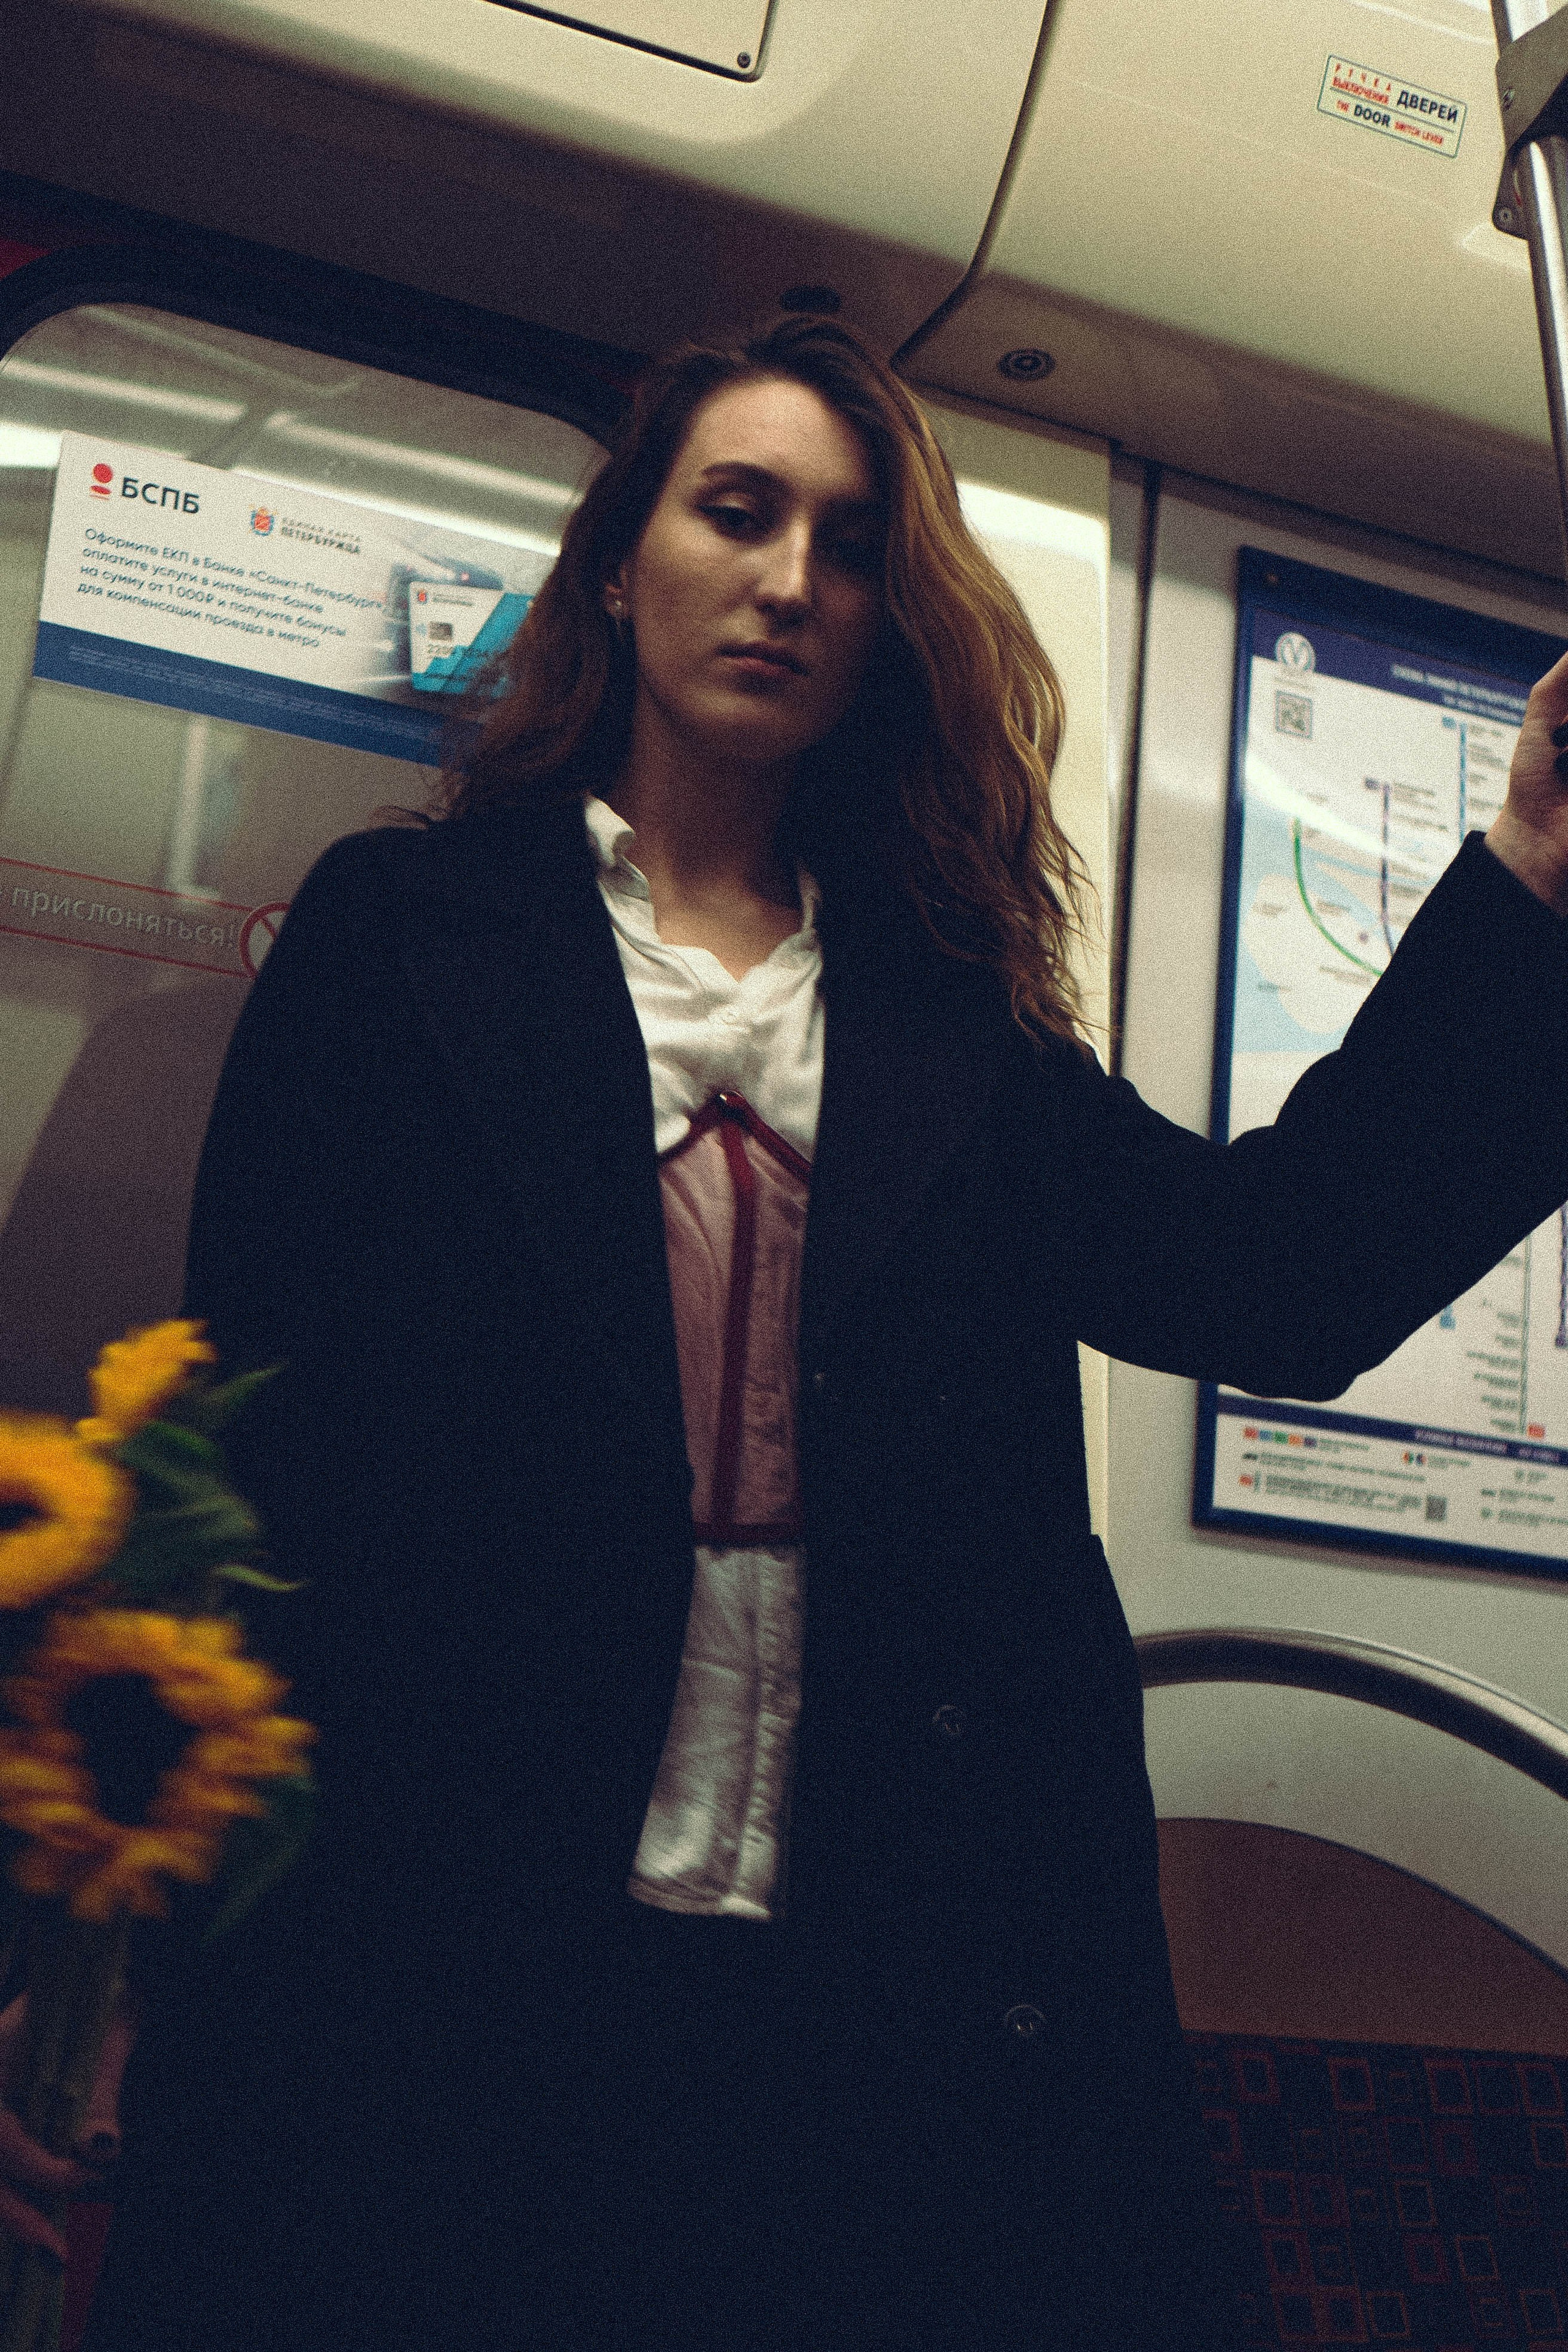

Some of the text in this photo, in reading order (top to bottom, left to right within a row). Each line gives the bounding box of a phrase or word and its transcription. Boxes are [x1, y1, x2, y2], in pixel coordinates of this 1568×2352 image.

[1354, 105, 1390, 127] DOOR
[1397, 91, 1458, 123] ДВЕРЕЙ
[122, 477, 200, 514] БСПБ
[82, 548, 323, 613] оплатите услуги в интернет-банке
[85, 527, 159, 556] Оформите
[162, 546, 189, 563] ЕКП
[192, 556, 200, 566] в
[203, 557, 245, 578] Банке
[77, 582, 320, 648] для компенсации проезда в метро
[80, 565, 99, 577] на
[102, 570, 145, 590] сумму
[148, 581, 164, 592] от
[230, 601, 293, 624] получите
[296, 616, 347, 636] бонусы
[11, 887, 235, 948] прислоняться!
